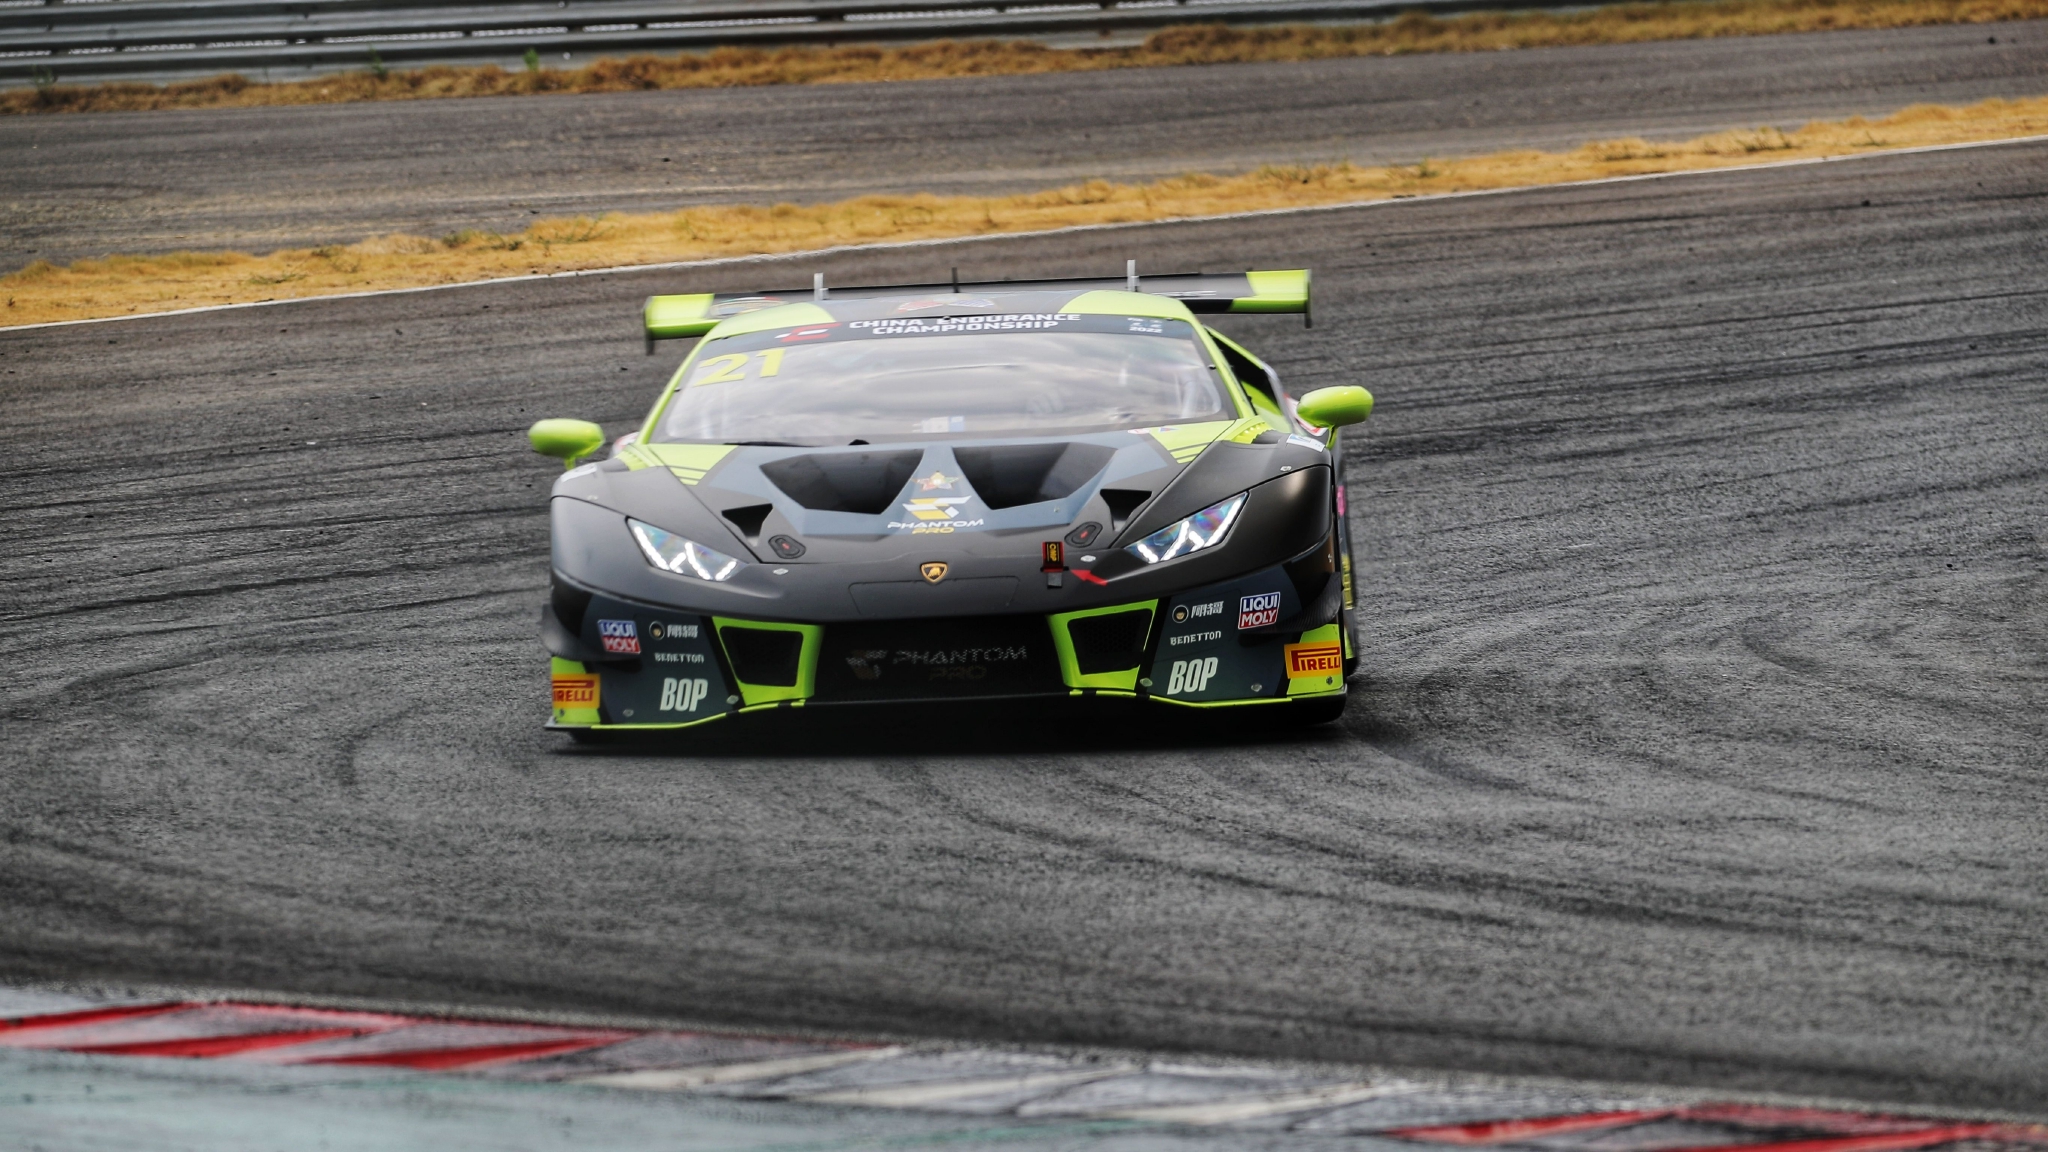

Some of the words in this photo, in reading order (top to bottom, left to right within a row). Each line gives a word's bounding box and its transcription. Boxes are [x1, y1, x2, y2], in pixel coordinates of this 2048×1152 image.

[849, 318, 924, 329] CHINA
[936, 313, 1082, 325] ENDURANCE
[872, 320, 1059, 335] CHAMPIONSHIP
[692, 348, 786, 387] 21
[887, 518, 985, 529] PHANTOM
[1242, 594, 1278, 612] LIQUI
[1240, 609, 1277, 627] MOLY
[600, 621, 635, 637] LIQUI
[603, 636, 638, 651] MOLY
[893, 646, 1027, 664] PHANTOM
[928, 664, 988, 681] PRO
[1167, 656, 1219, 695] BOP
[659, 677, 709, 712] BOP
